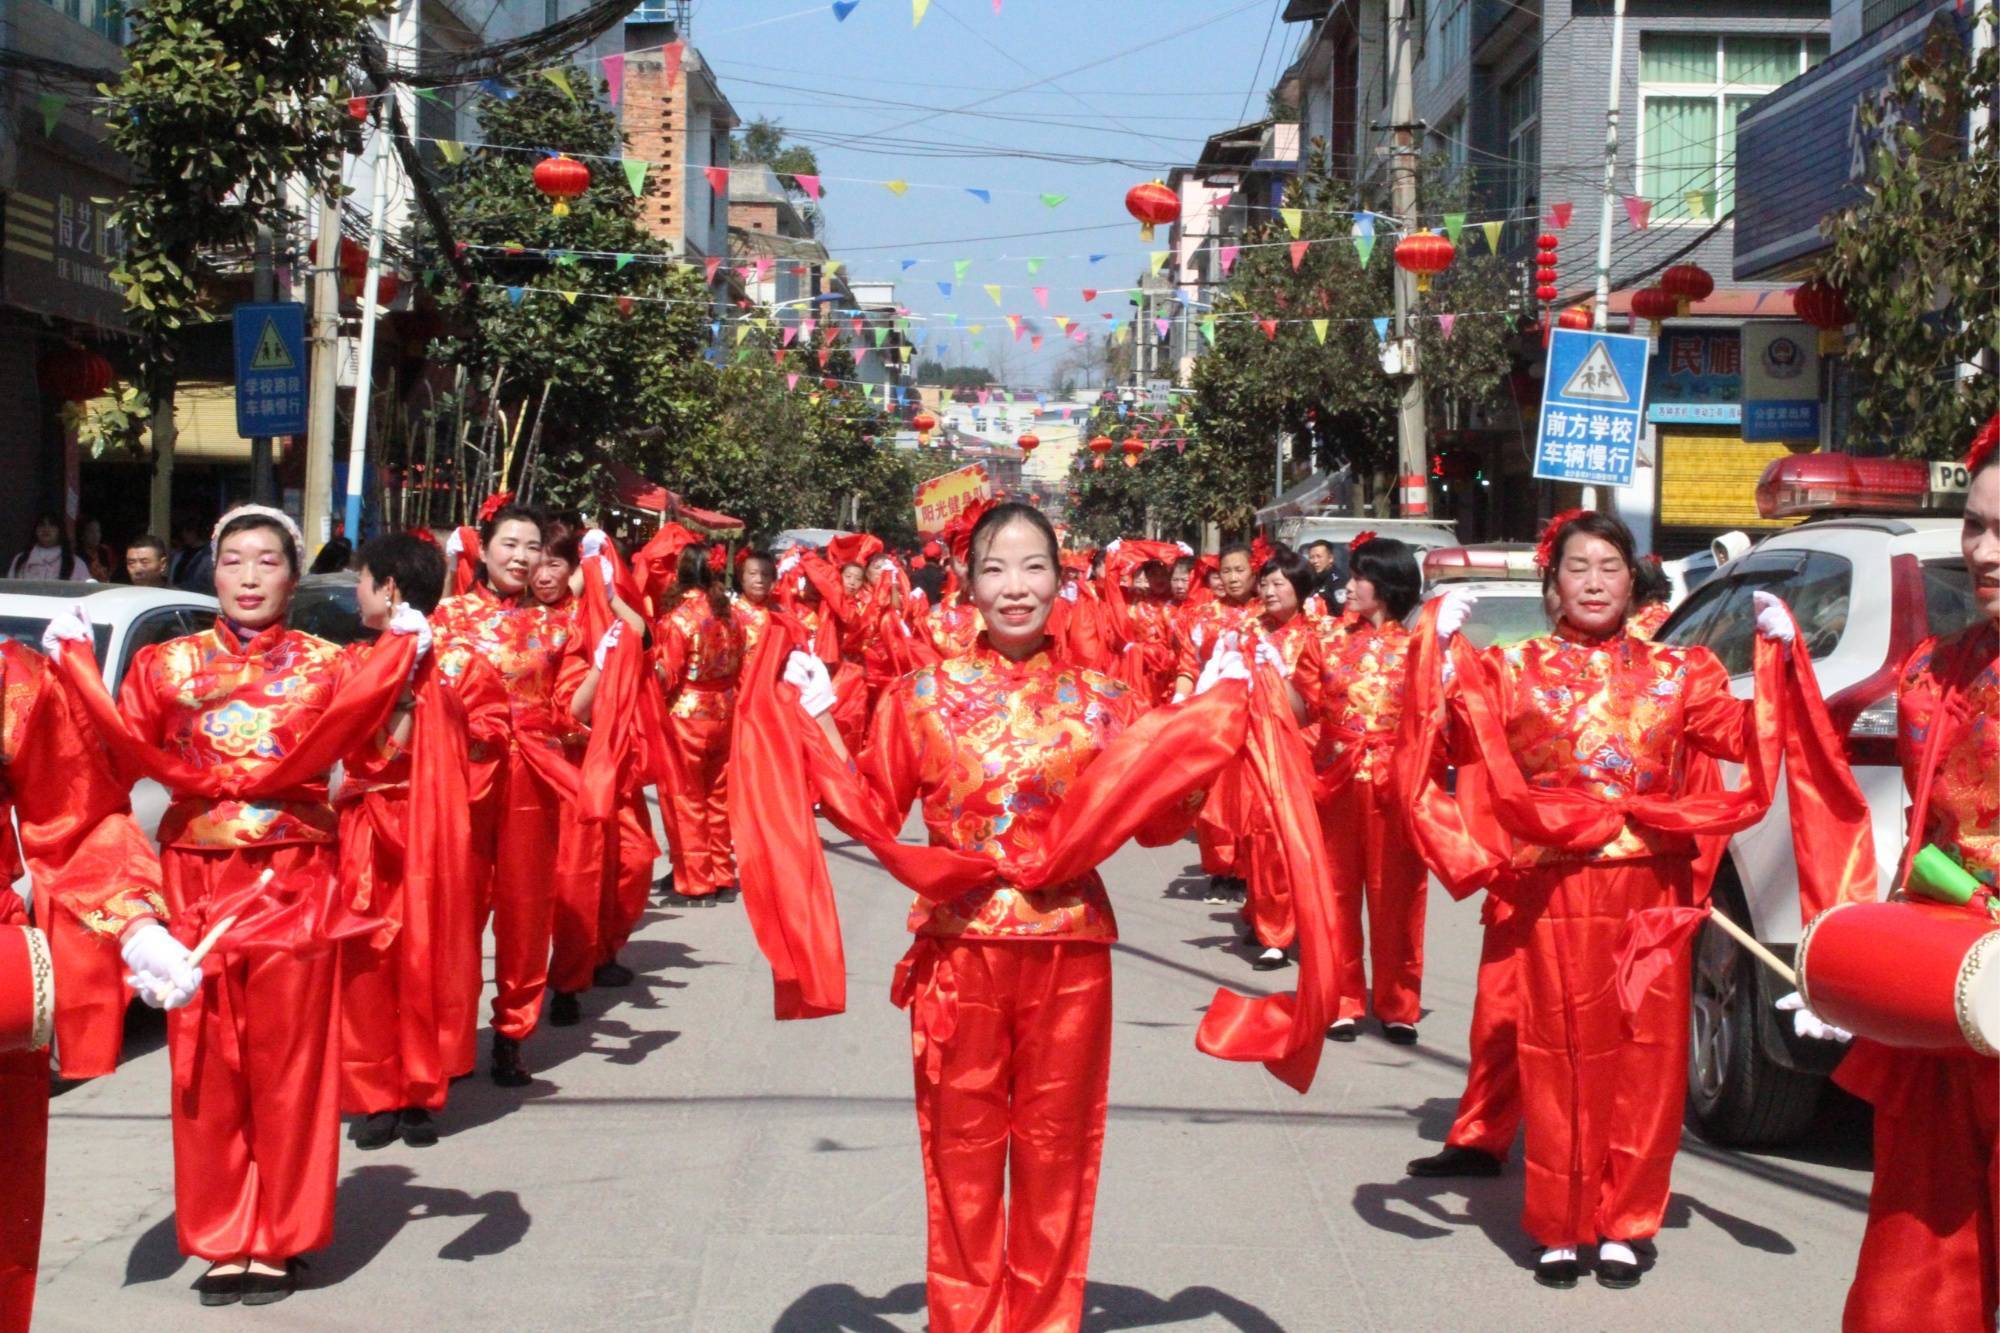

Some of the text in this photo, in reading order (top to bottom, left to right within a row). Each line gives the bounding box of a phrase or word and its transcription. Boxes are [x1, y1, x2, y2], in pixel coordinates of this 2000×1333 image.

[245, 377, 300, 396] 学校路段
[245, 398, 300, 417] 车辆慢行
[1546, 410, 1633, 443] 前方学校
[1542, 440, 1630, 473] 车辆慢行
